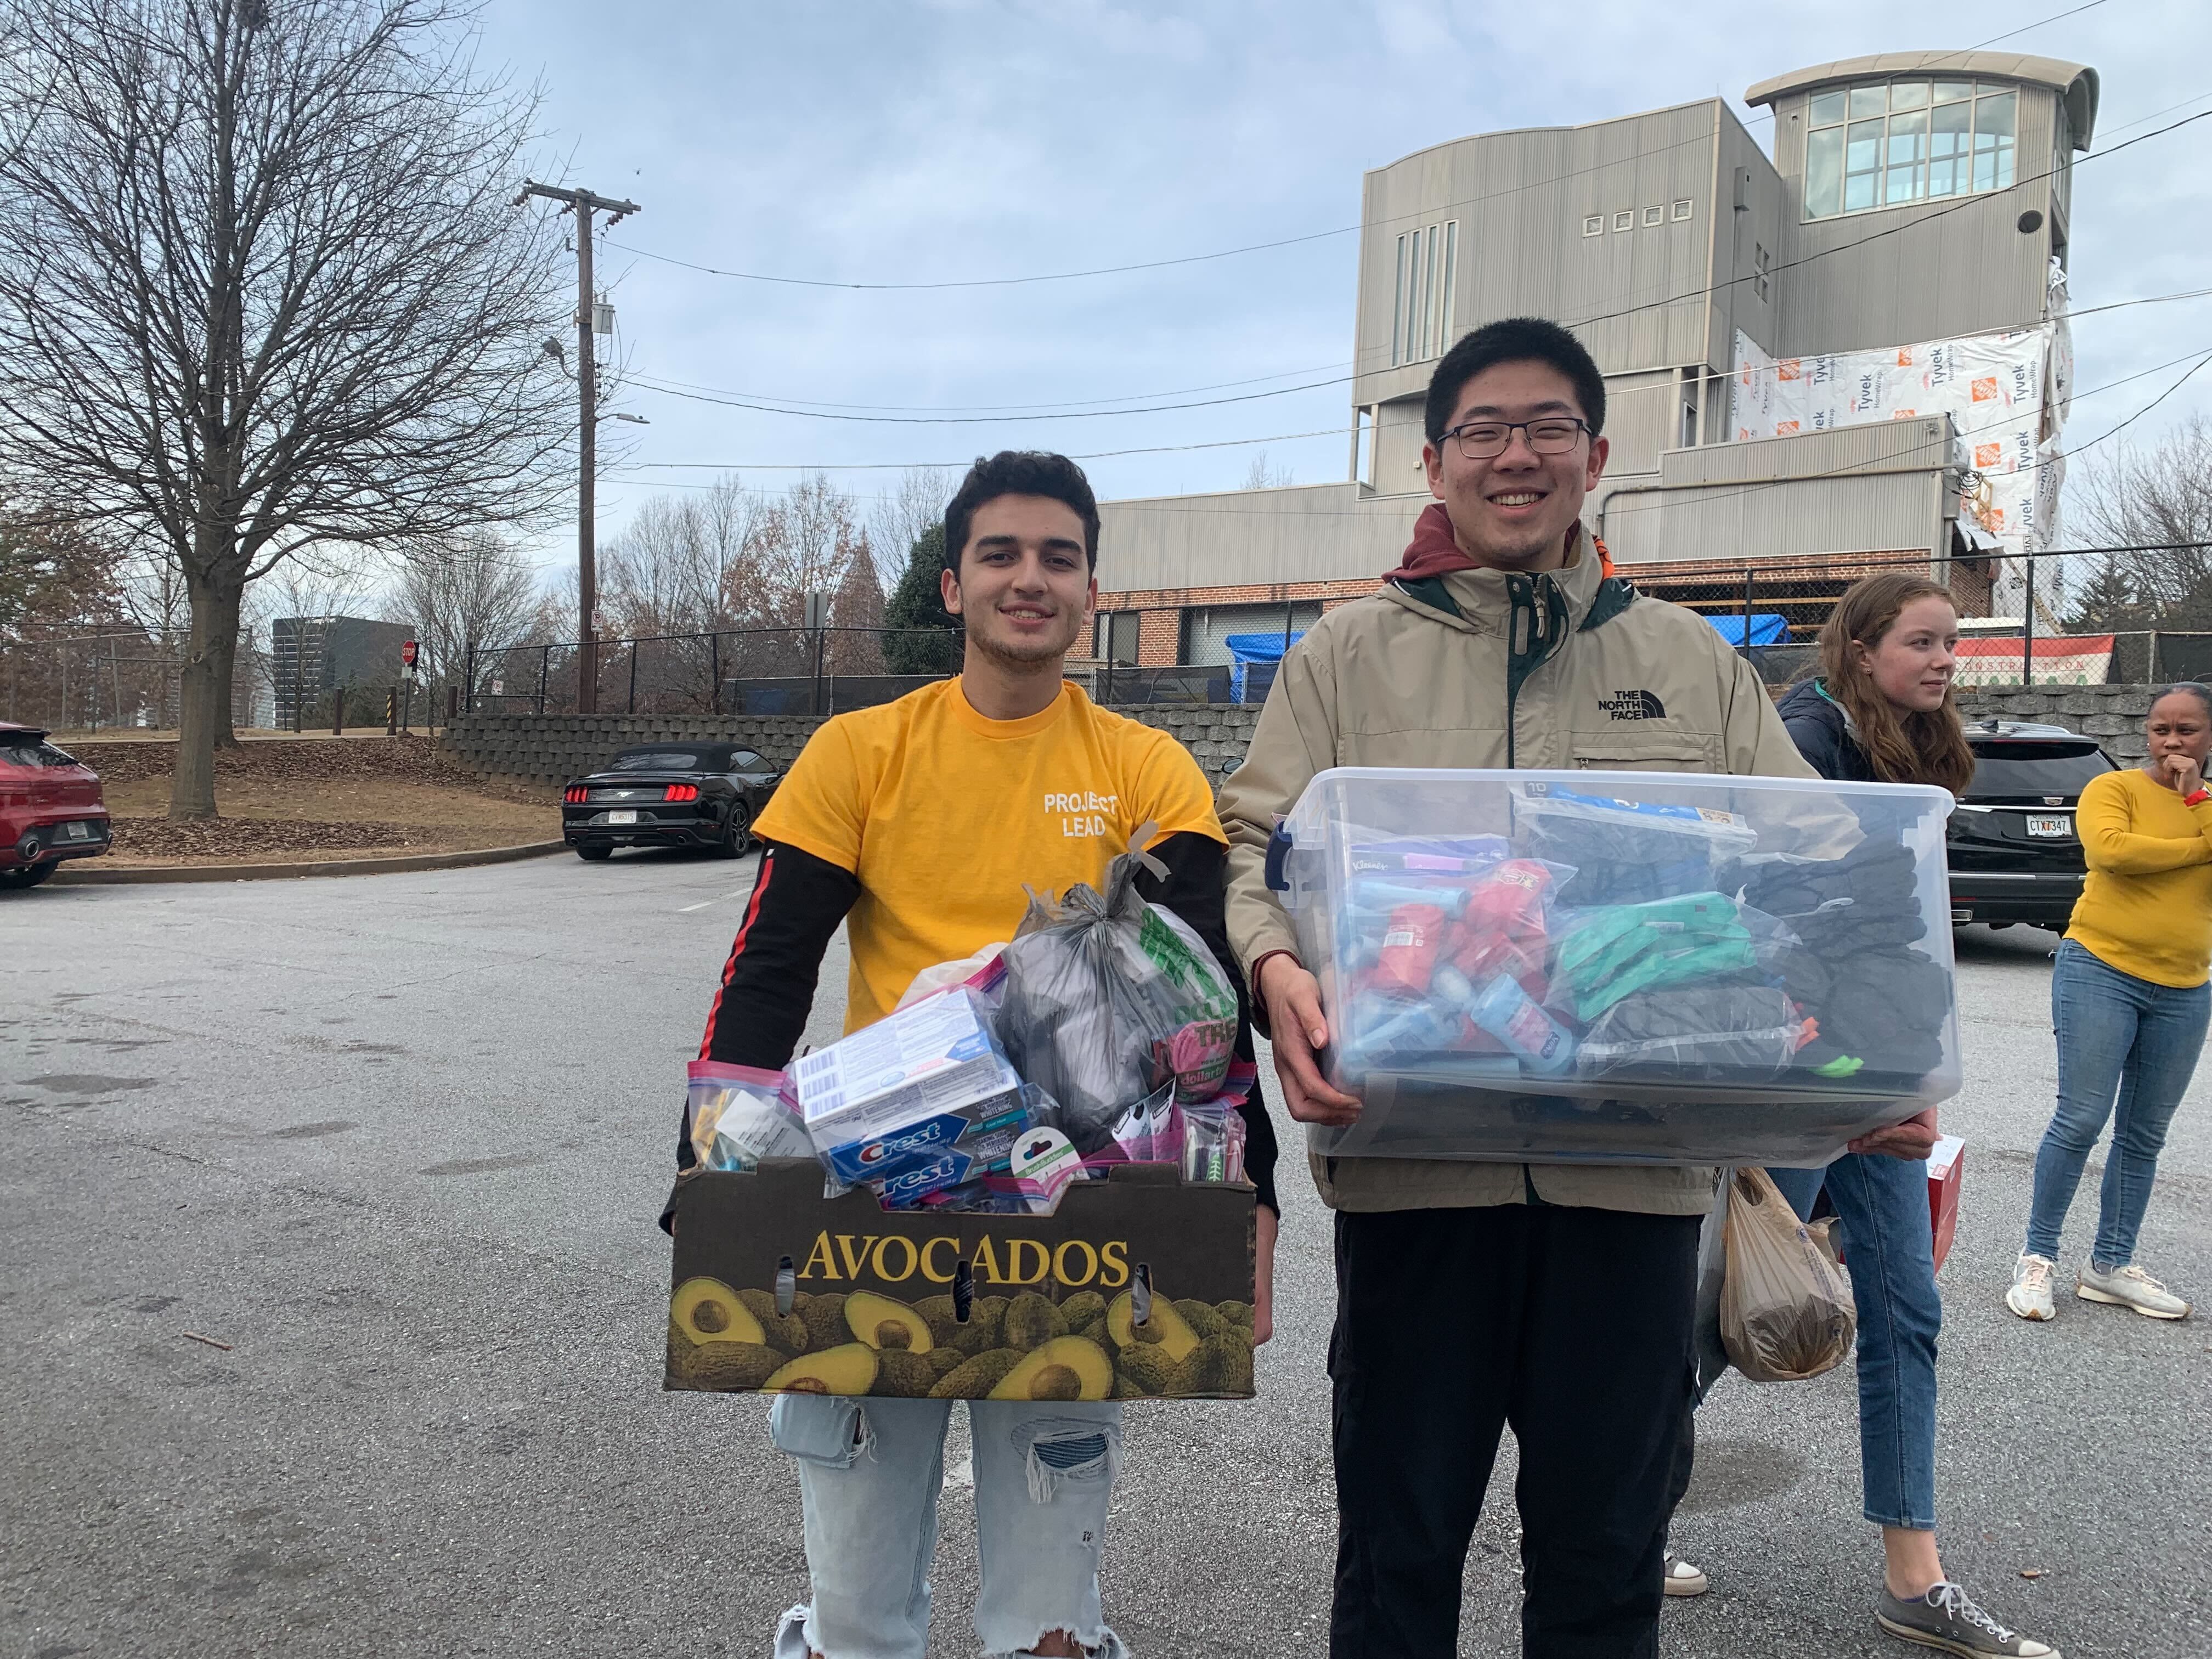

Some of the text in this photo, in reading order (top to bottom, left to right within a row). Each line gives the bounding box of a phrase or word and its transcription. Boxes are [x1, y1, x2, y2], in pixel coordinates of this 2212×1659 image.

[1930, 348, 1946, 387] Tyvek
[1858, 374, 1874, 411] Tyvek
[1874, 371, 1884, 408] HomeWrap
[2012, 364, 2029, 404] Tyvek
[2017, 431, 2034, 470] Tyvek
[403, 647, 415, 657] STOP
[1598, 701, 1640, 710] NORTH
[1615, 690, 1640, 699] THE
[1611, 710, 1642, 720] FACE
[1045, 791, 1117, 815] PROJECT
[1063, 816, 1105, 837] LEAD
[2030, 820, 2066, 831] CTX7347
[1352, 860, 1389, 872] Kleenex
[860, 1121, 941, 1164] Crest
[798, 1231, 1128, 1287] AVOCADOS
